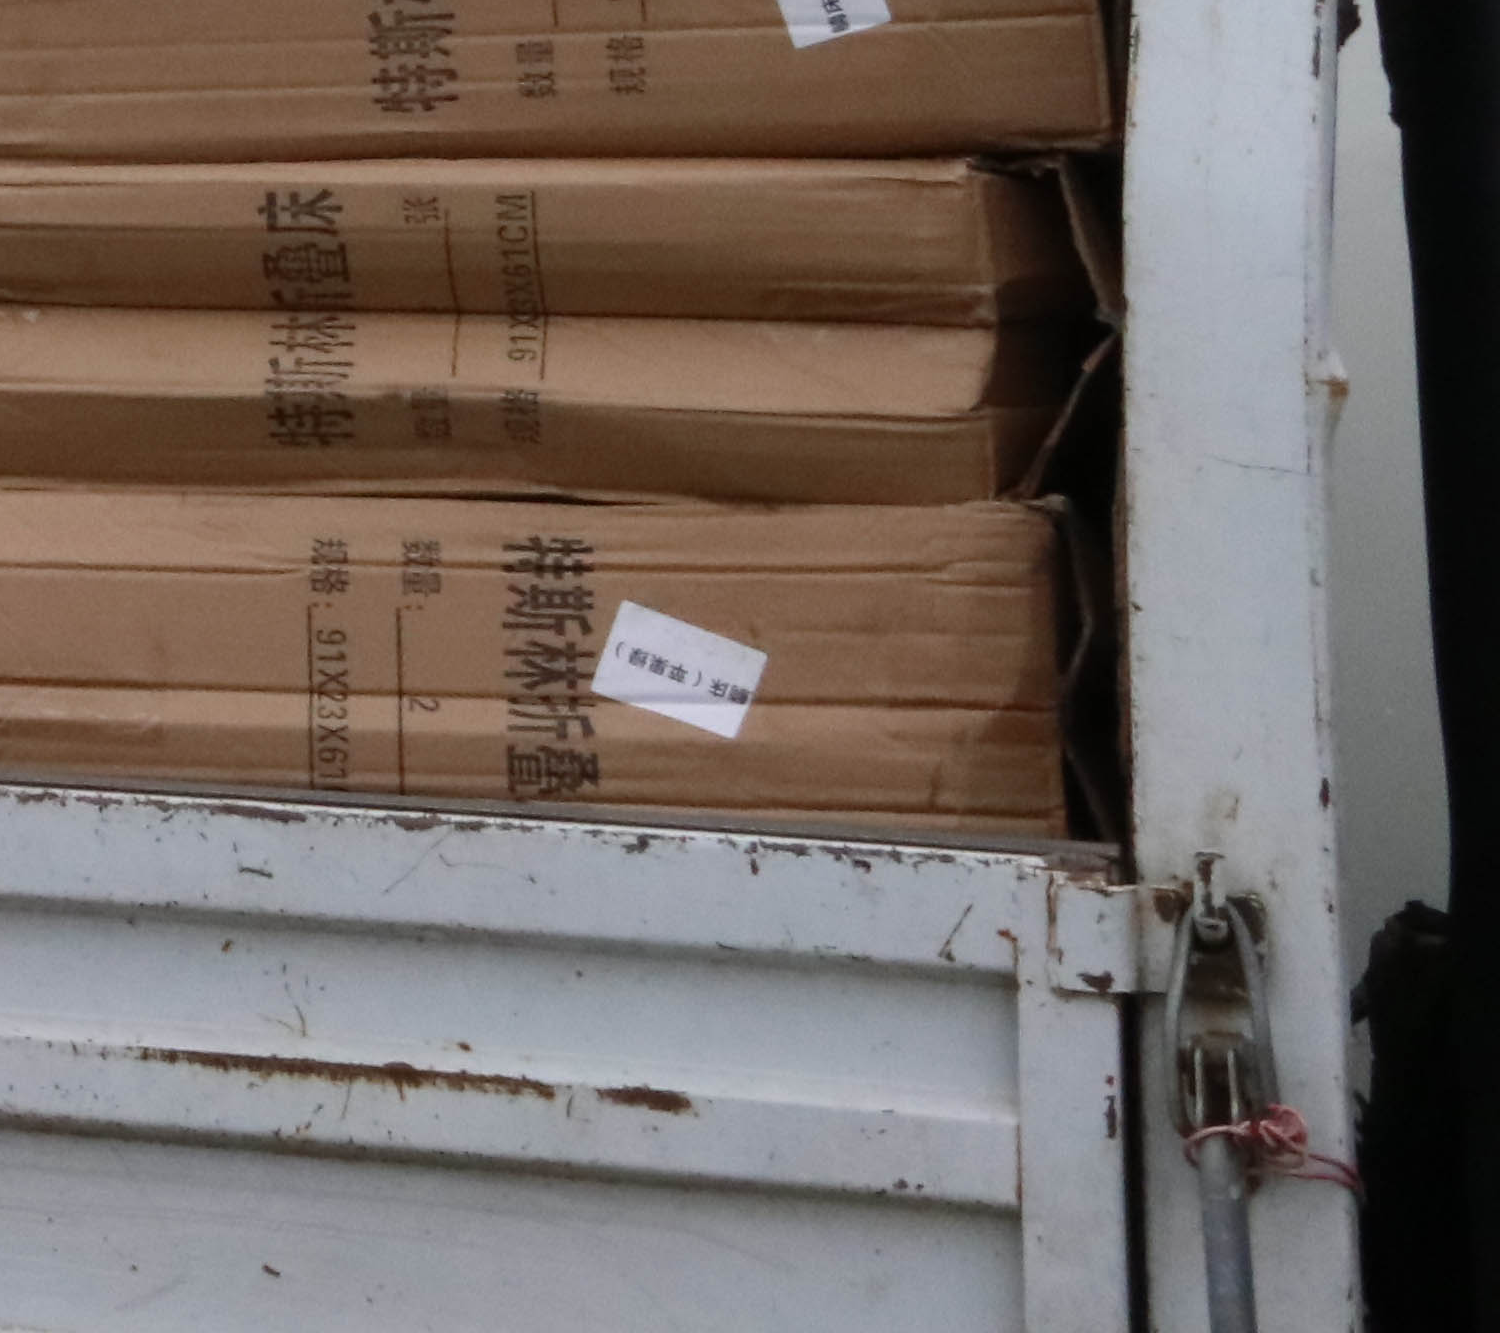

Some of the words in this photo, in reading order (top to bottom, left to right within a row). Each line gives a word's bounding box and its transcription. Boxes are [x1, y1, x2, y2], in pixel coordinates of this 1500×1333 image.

[257, 189, 357, 448] 特斯林折叠床
[493, 193, 541, 363] 91X3X61CM
[309, 536, 350, 609] 规格：
[315, 627, 350, 792] 91X23X61
[408, 695, 442, 713] 2
[502, 534, 599, 797] 特斯林折叠
